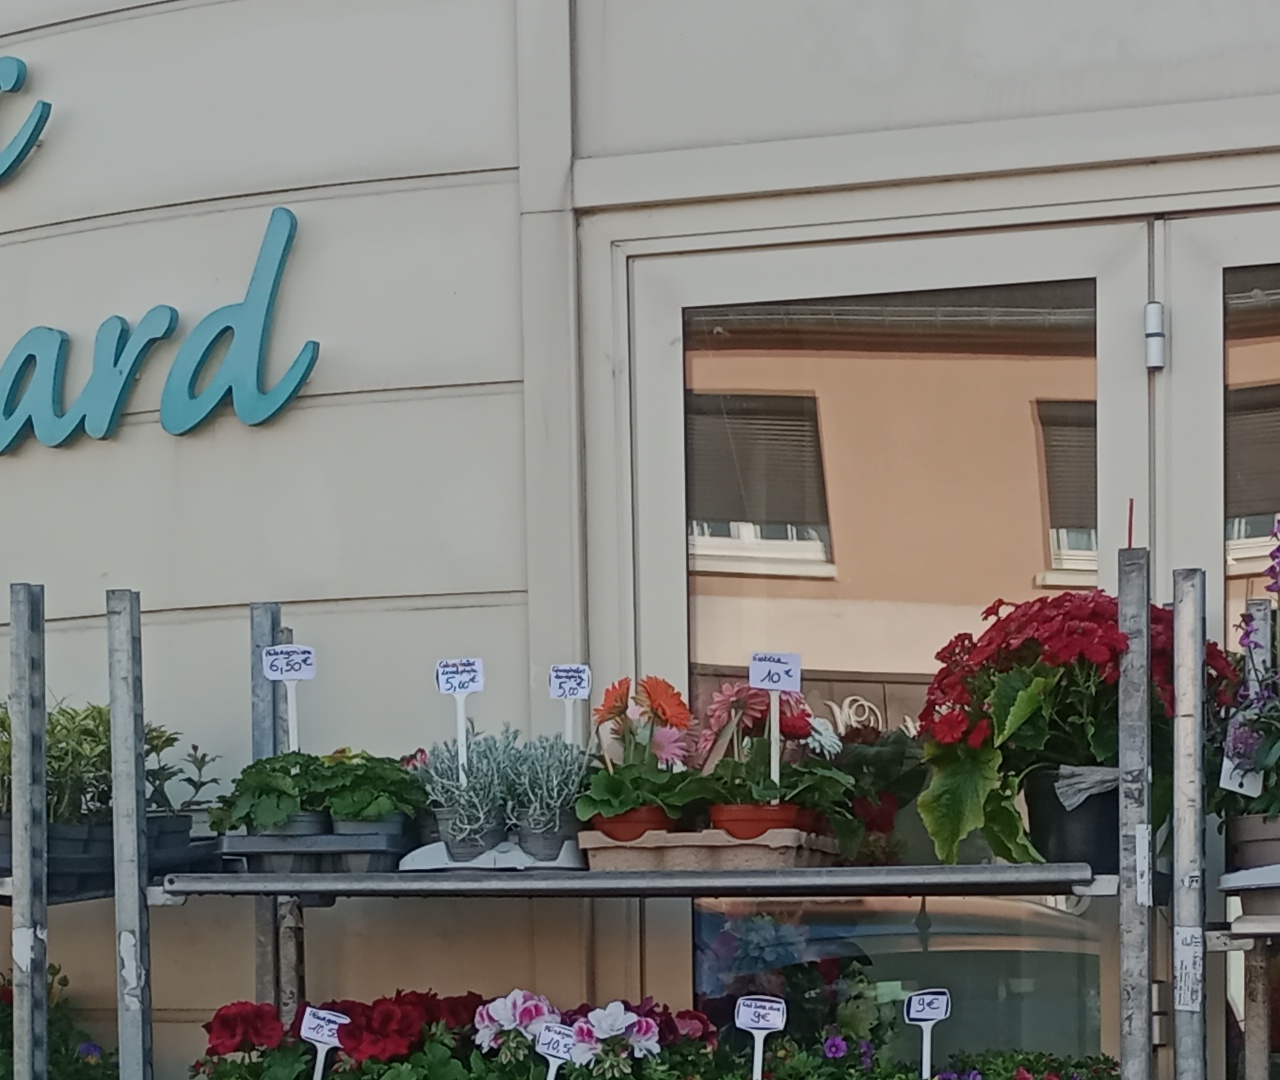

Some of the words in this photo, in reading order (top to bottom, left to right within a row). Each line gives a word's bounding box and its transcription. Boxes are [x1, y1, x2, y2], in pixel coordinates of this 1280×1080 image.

[269, 657, 313, 675] 6,50€
[760, 669, 793, 684] 10€
[915, 998, 940, 1013] 9€
[750, 1011, 770, 1023] 9€
